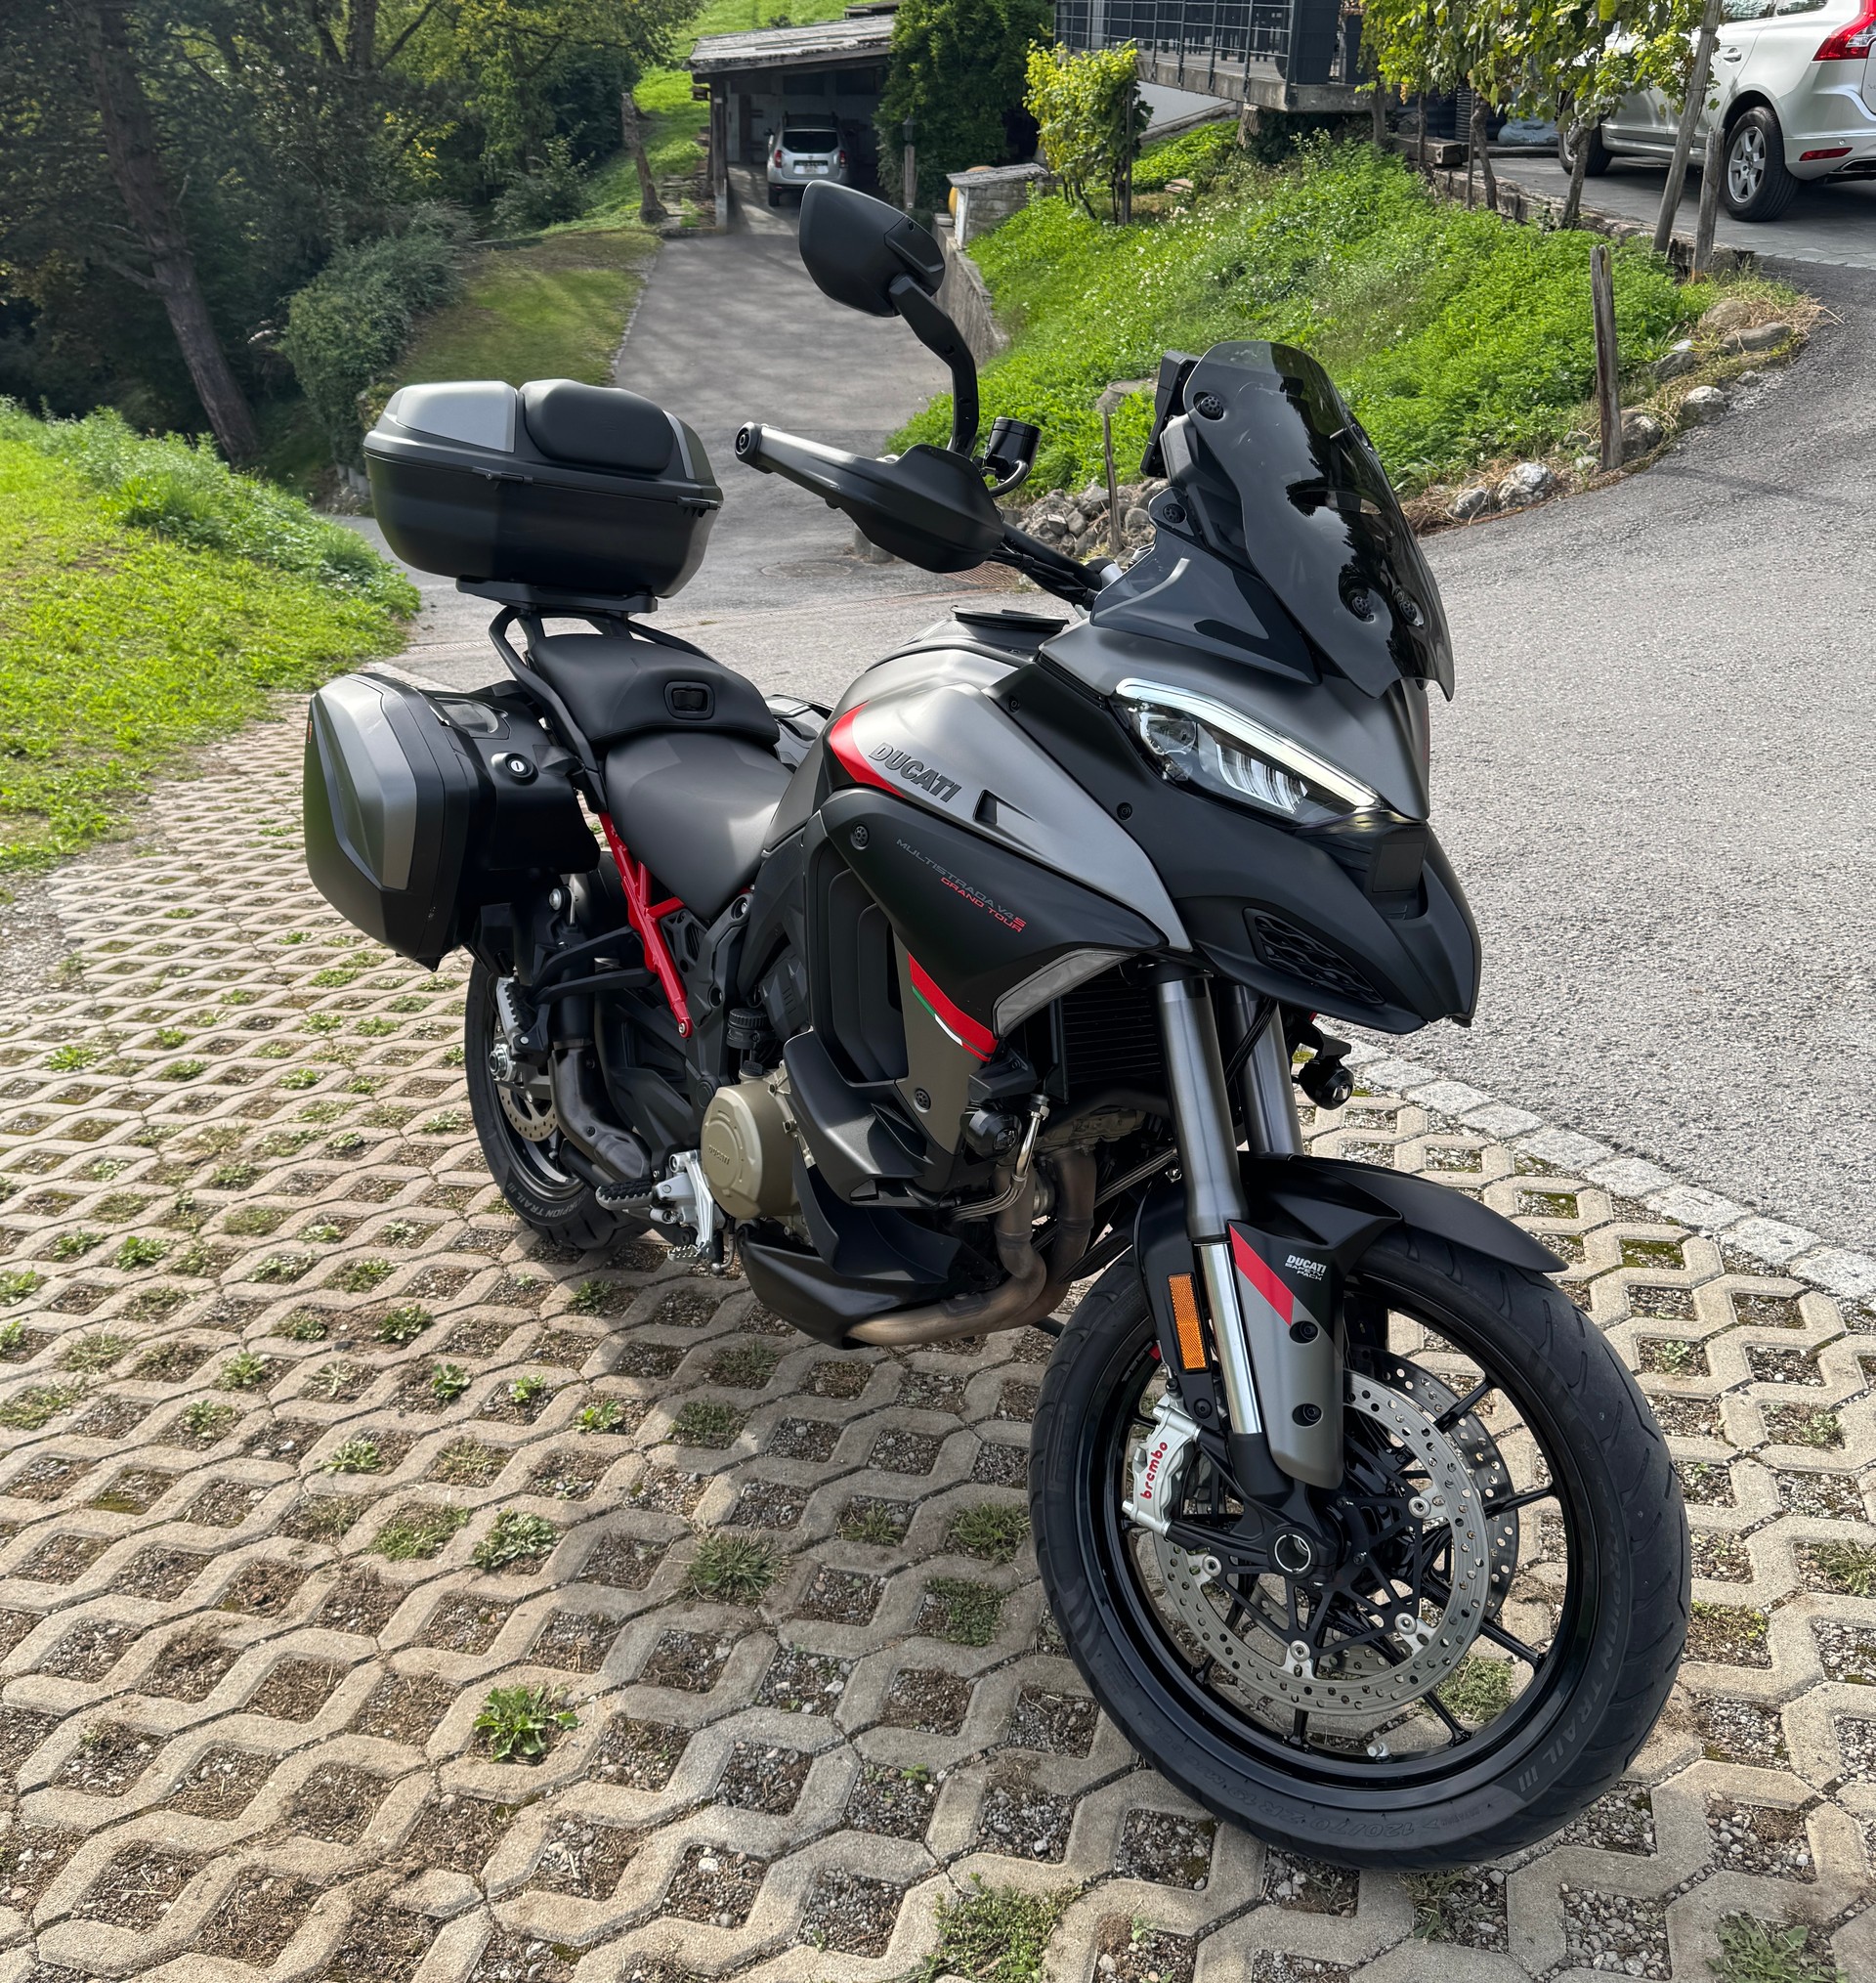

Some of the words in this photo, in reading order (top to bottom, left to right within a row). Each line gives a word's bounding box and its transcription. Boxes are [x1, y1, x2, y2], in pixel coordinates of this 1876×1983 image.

[869, 742, 961, 802] DUCATI
[896, 839, 995, 908] MULTISTRADA
[998, 904, 1027, 928] V4S
[940, 877, 985, 908] GRAND
[987, 906, 1023, 933] TOUR
[516, 1194, 544, 1216] TRAIL
[1284, 1262, 1324, 1276] SAFETY
[1286, 1254, 1327, 1273] DUCATI
[1297, 1270, 1323, 1281] PACK
[1140, 1442, 1169, 1500] brembo
[1542, 1679, 1603, 1765] TRAIL
